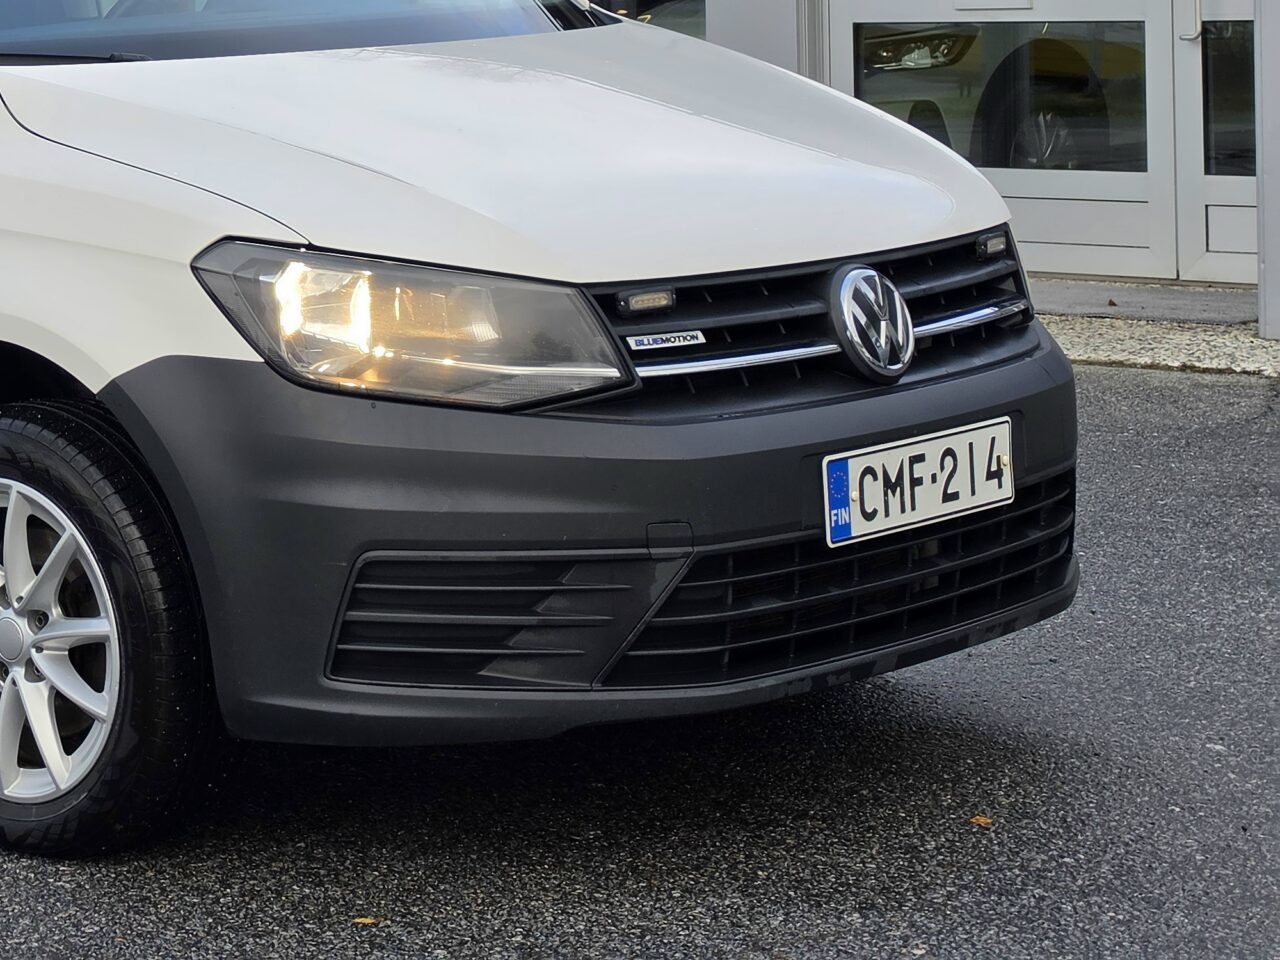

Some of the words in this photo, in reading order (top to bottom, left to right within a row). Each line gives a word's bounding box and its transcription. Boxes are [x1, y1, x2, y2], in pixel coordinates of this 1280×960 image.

[634, 333, 699, 347] BLUEMOTION
[859, 436, 1004, 522] CMF-214
[831, 507, 850, 527] FIN
